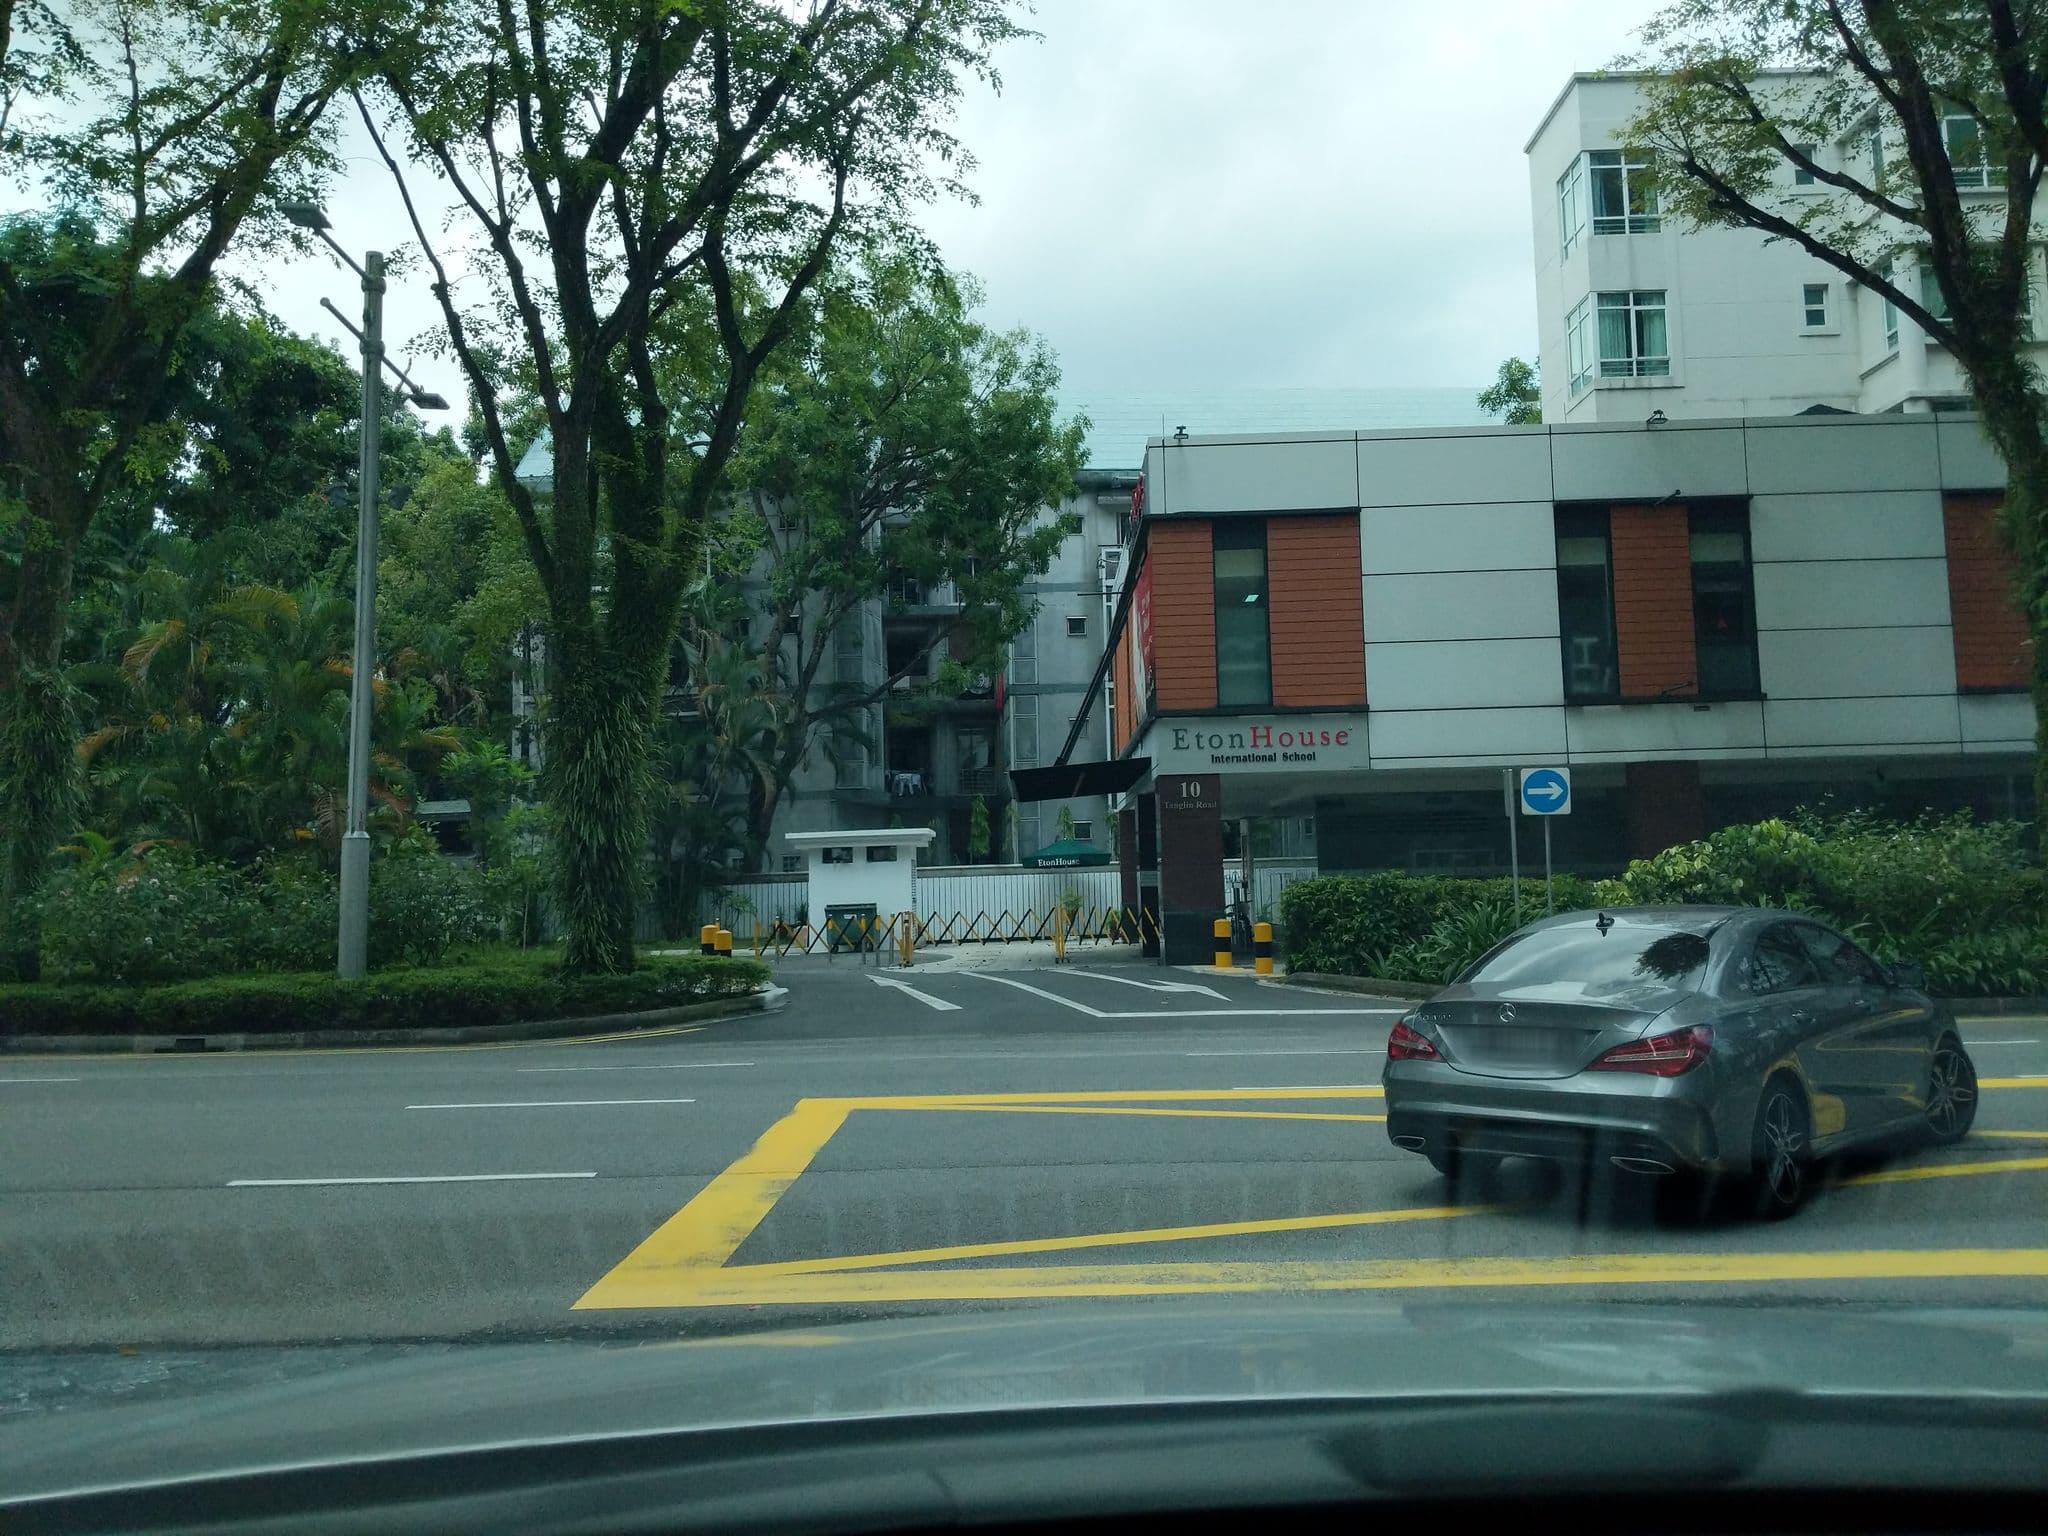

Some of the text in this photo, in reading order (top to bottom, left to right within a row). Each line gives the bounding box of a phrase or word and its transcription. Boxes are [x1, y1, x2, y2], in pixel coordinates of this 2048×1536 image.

[1172, 726, 1349, 750] EtonHouse
[1211, 752, 1316, 764] International School
[1181, 781, 1201, 798] 10
[1196, 800, 1217, 809] Road
[1038, 858, 1080, 867] EtonHouse
